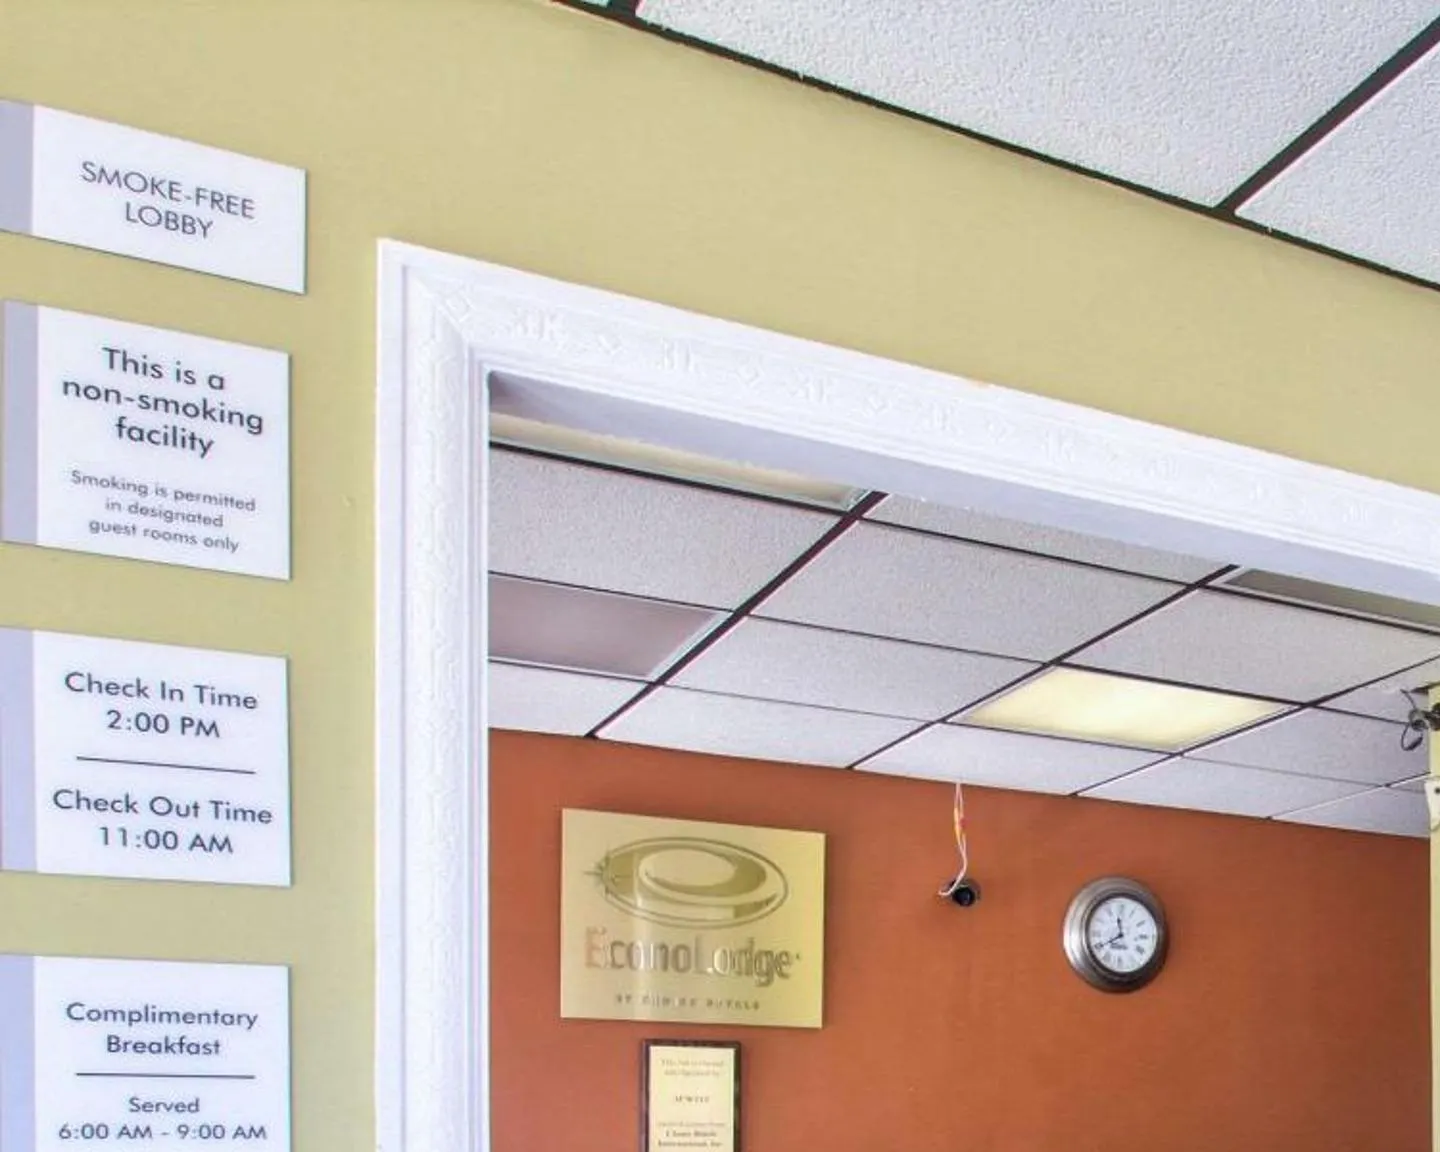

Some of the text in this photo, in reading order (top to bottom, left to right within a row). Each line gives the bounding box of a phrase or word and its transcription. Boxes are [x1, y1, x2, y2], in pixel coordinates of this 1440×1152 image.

[81, 161, 255, 219] SMOKE-FREE
[126, 201, 213, 238] LOBBY
[102, 347, 224, 390] This is a
[62, 378, 264, 435] non-smoking
[116, 416, 214, 458] facility
[72, 470, 255, 511] Smoking is permitted
[105, 498, 223, 528] in designated
[88, 520, 239, 553] guest rooms only
[65, 672, 257, 709] Check In Time
[107, 710, 219, 737] 2:00 PM
[53, 789, 272, 824] Check Out Time
[100, 827, 233, 853] 11:00 AM
[67, 1002, 257, 1030] Complimentary
[107, 1035, 220, 1055] Breakfast
[129, 1097, 200, 1113] Served
[59, 1123, 109, 1139] 6:00
[117, 1125, 152, 1139] AM
[177, 1124, 225, 1139] 9:00
[232, 1126, 266, 1139] AM
